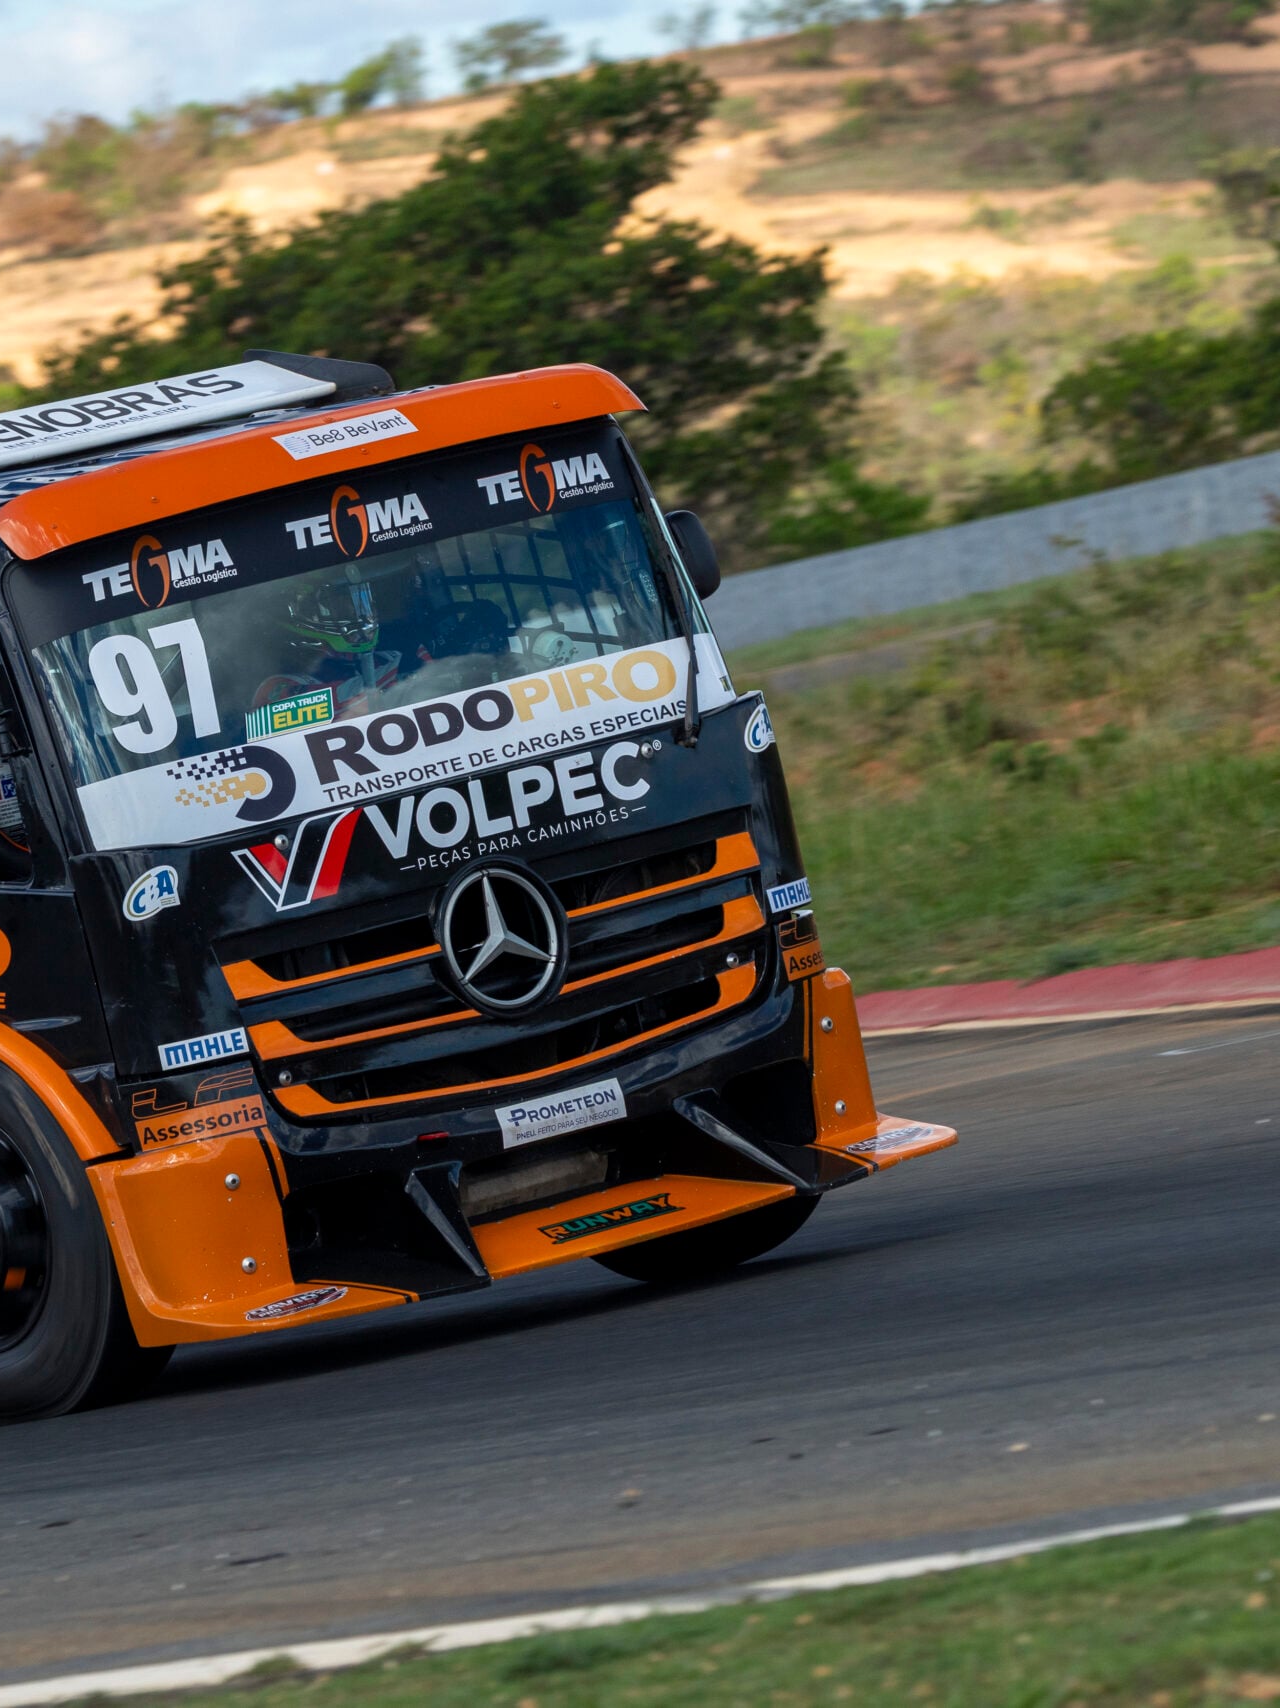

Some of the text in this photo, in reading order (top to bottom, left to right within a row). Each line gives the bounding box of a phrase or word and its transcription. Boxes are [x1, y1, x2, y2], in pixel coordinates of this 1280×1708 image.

[95, 404, 196, 430] BRASILEIRA
[307, 413, 408, 447] Be8 BeVant
[477, 443, 611, 513] TEGMA
[559, 480, 615, 500] Gestão Logística
[285, 485, 429, 557] TEGMA
[372, 521, 433, 543] Gestão Logística
[81, 534, 235, 608] TEGMA
[173, 567, 238, 589] Gestão Logística
[88, 618, 221, 754] 97
[272, 693, 328, 713] COPA TRUCK
[273, 702, 329, 729] ELITE
[304, 650, 677, 785] RODOPIRO
[323, 699, 688, 804] TRANSPORTE DE CARGAS ESPECIAIS
[362, 741, 651, 860] VOLPEC
[417, 807, 630, 873] PEÇAS PARA CAMINHÕES
[771, 878, 812, 909] MAHL
[164, 1031, 245, 1066] MAHLE
[143, 1104, 264, 1145] Assessoria
[507, 1089, 617, 1127] PROMETEON
[537, 1123, 557, 1135] FEITO
[557, 1120, 575, 1131] PARA
[575, 1117, 588, 1127] SEU
[543, 1196, 668, 1238] RUNWAY
